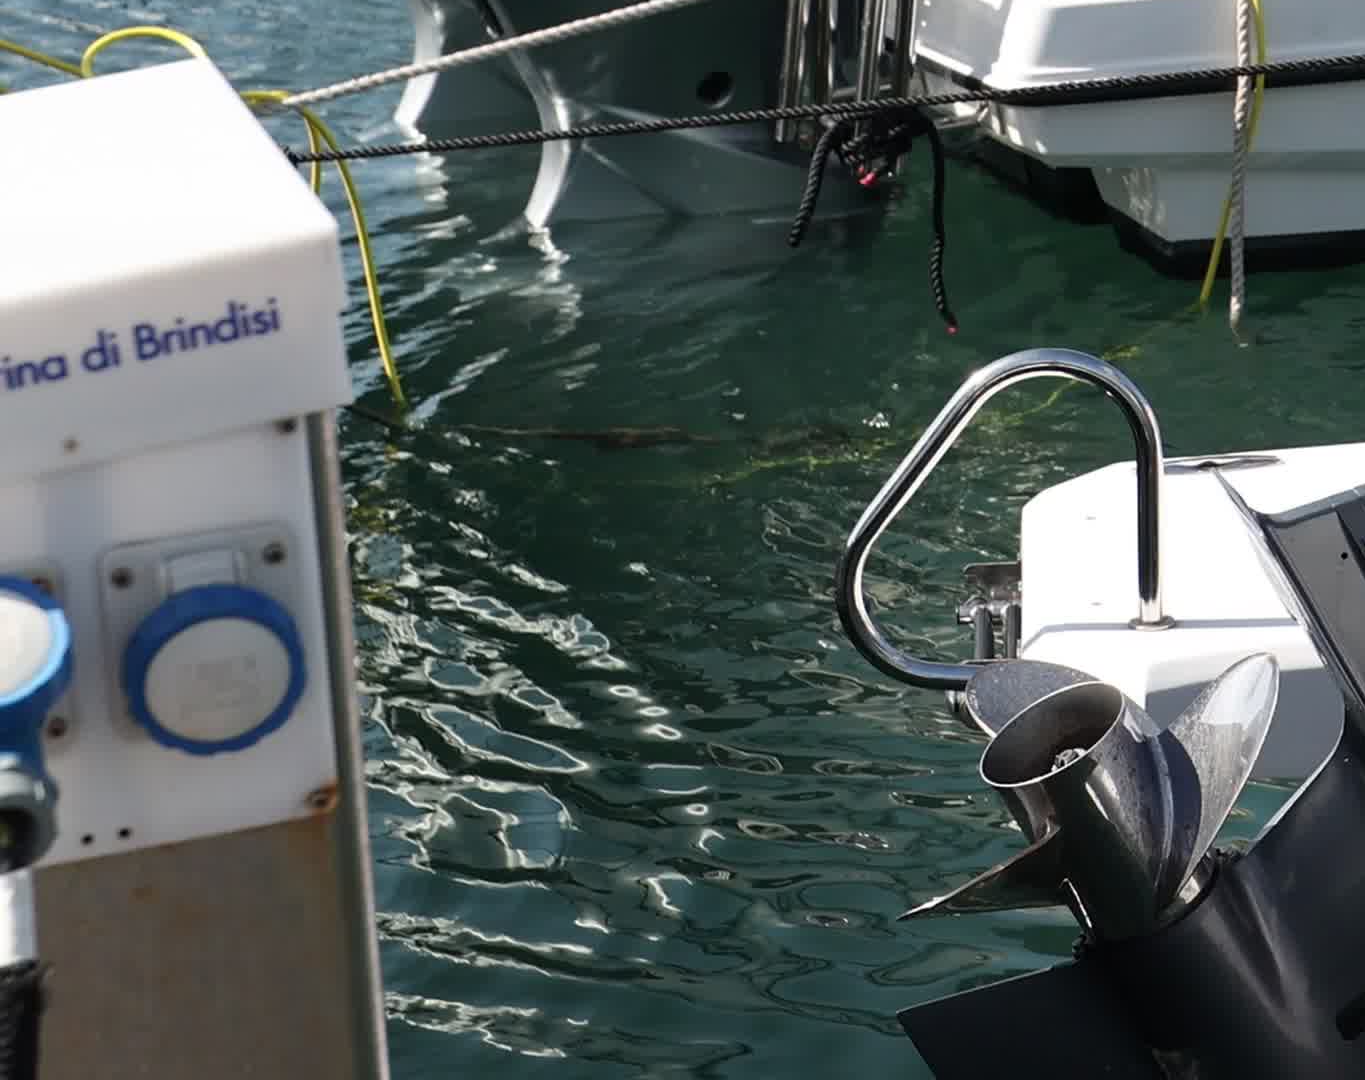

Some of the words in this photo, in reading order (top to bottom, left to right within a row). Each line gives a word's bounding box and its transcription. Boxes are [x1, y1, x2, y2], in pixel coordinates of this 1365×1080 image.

[0, 354, 69, 391] ina
[81, 328, 121, 372] di
[132, 296, 281, 360] Brindisi
